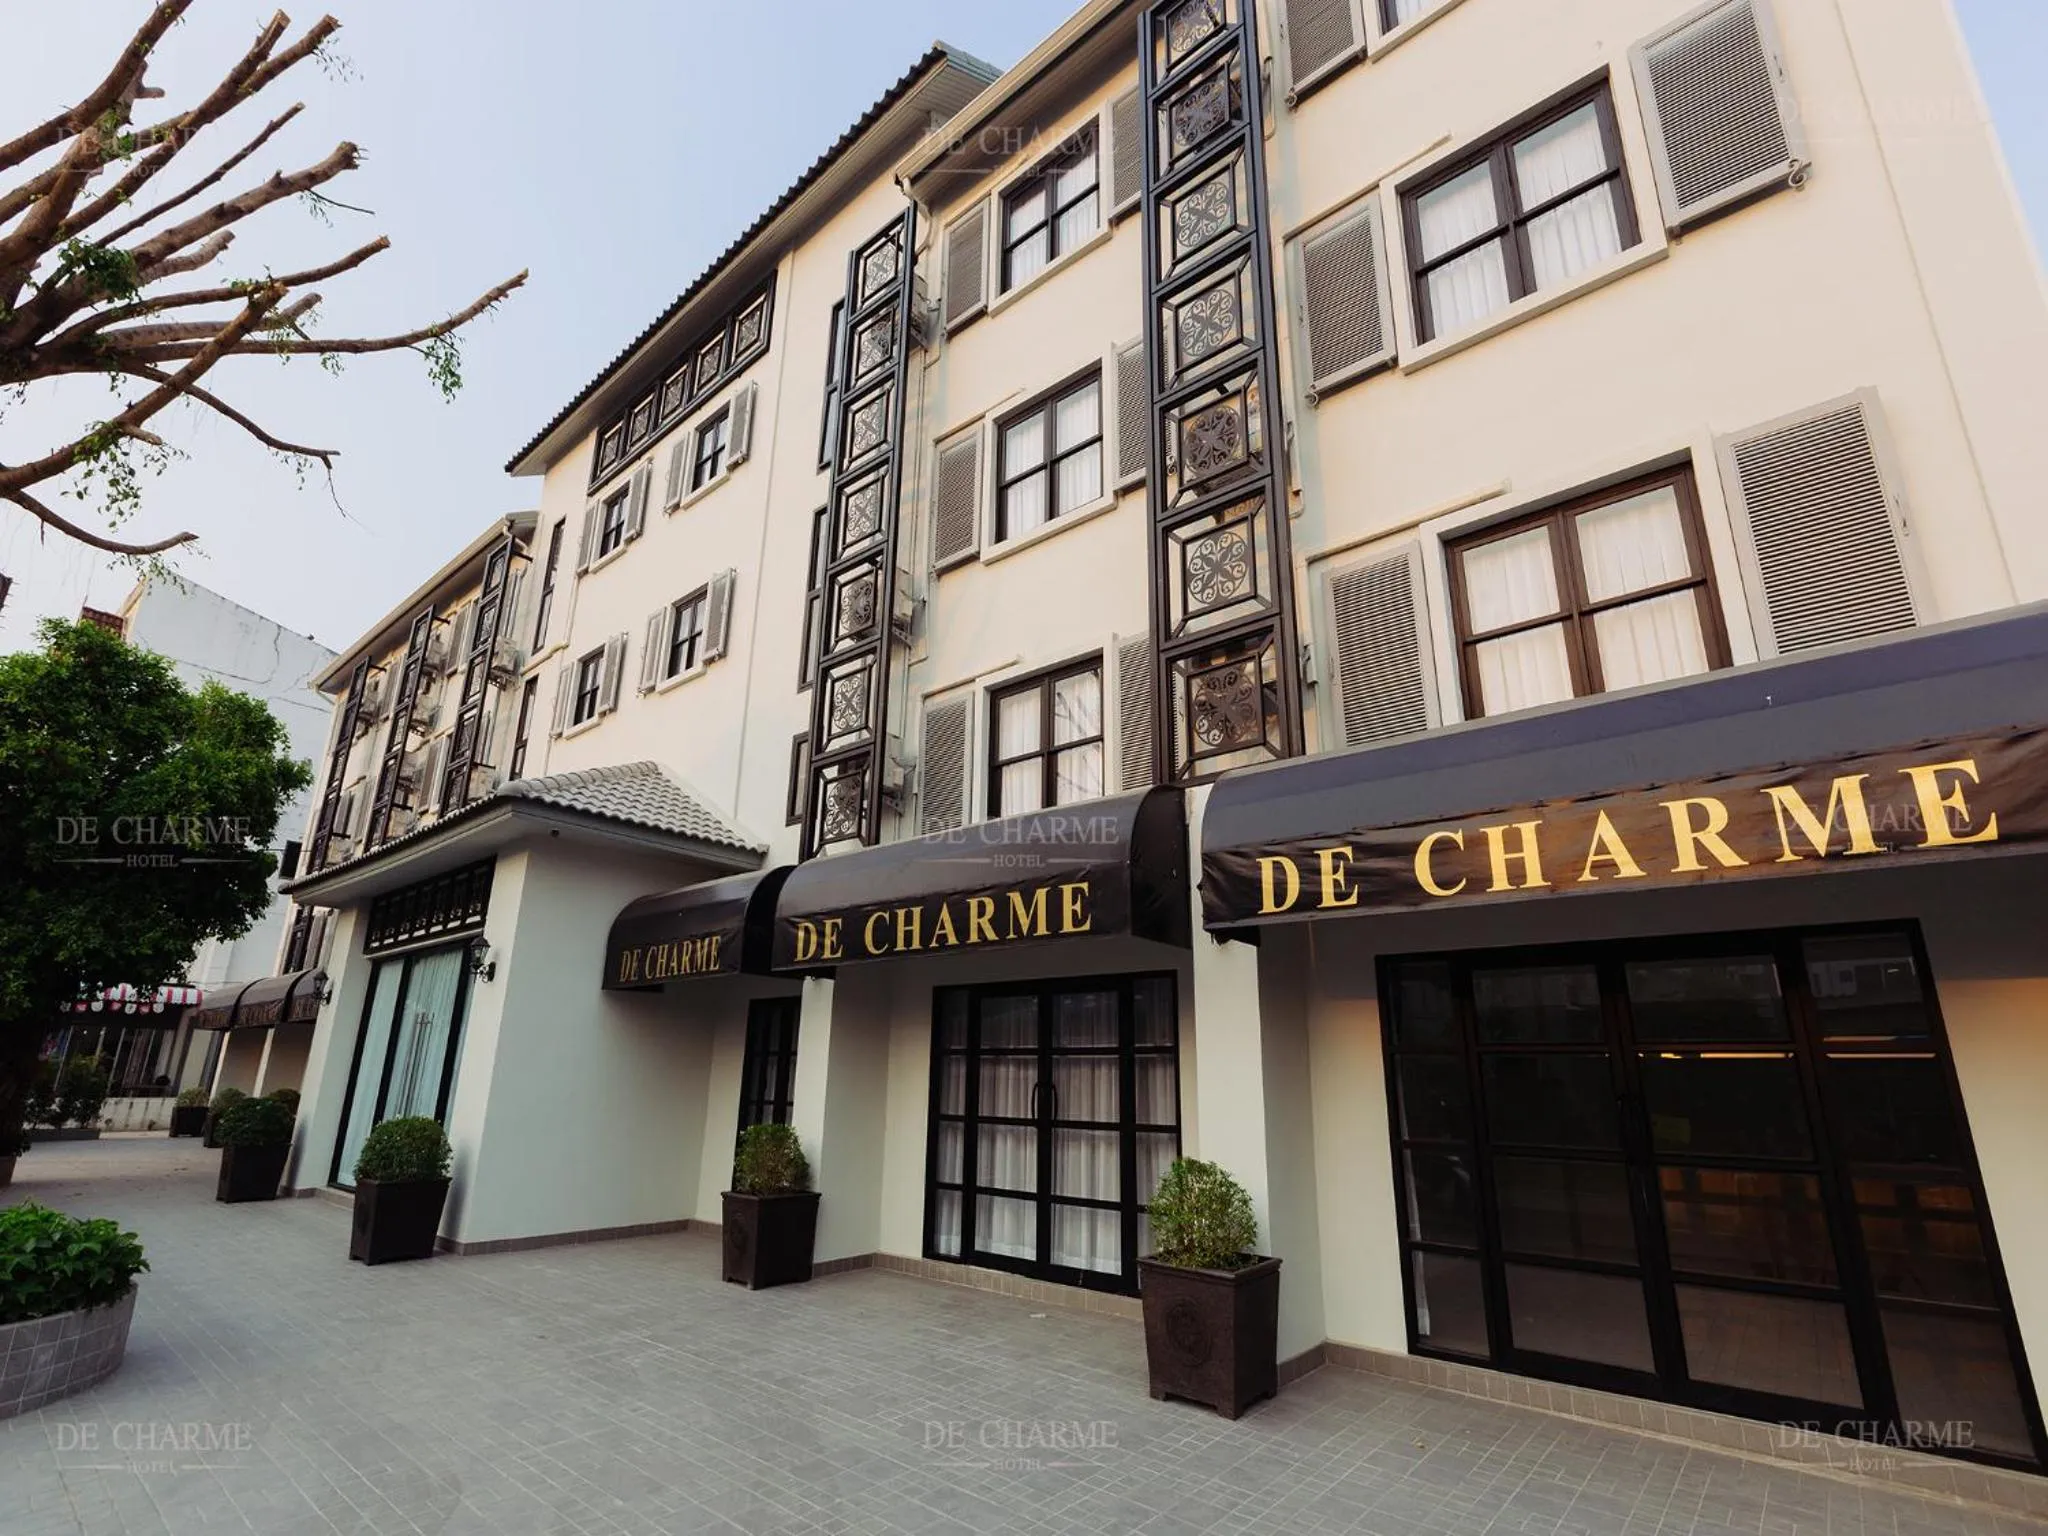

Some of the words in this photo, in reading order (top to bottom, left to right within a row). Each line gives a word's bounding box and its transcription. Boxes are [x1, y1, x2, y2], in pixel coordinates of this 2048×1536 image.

[1256, 845, 1358, 915] DE
[1413, 759, 1999, 897] CHARME
[618, 949, 641, 983] DE
[644, 935, 722, 981] CHARME
[794, 916, 843, 962] DE
[864, 881, 1092, 955] CHARME
